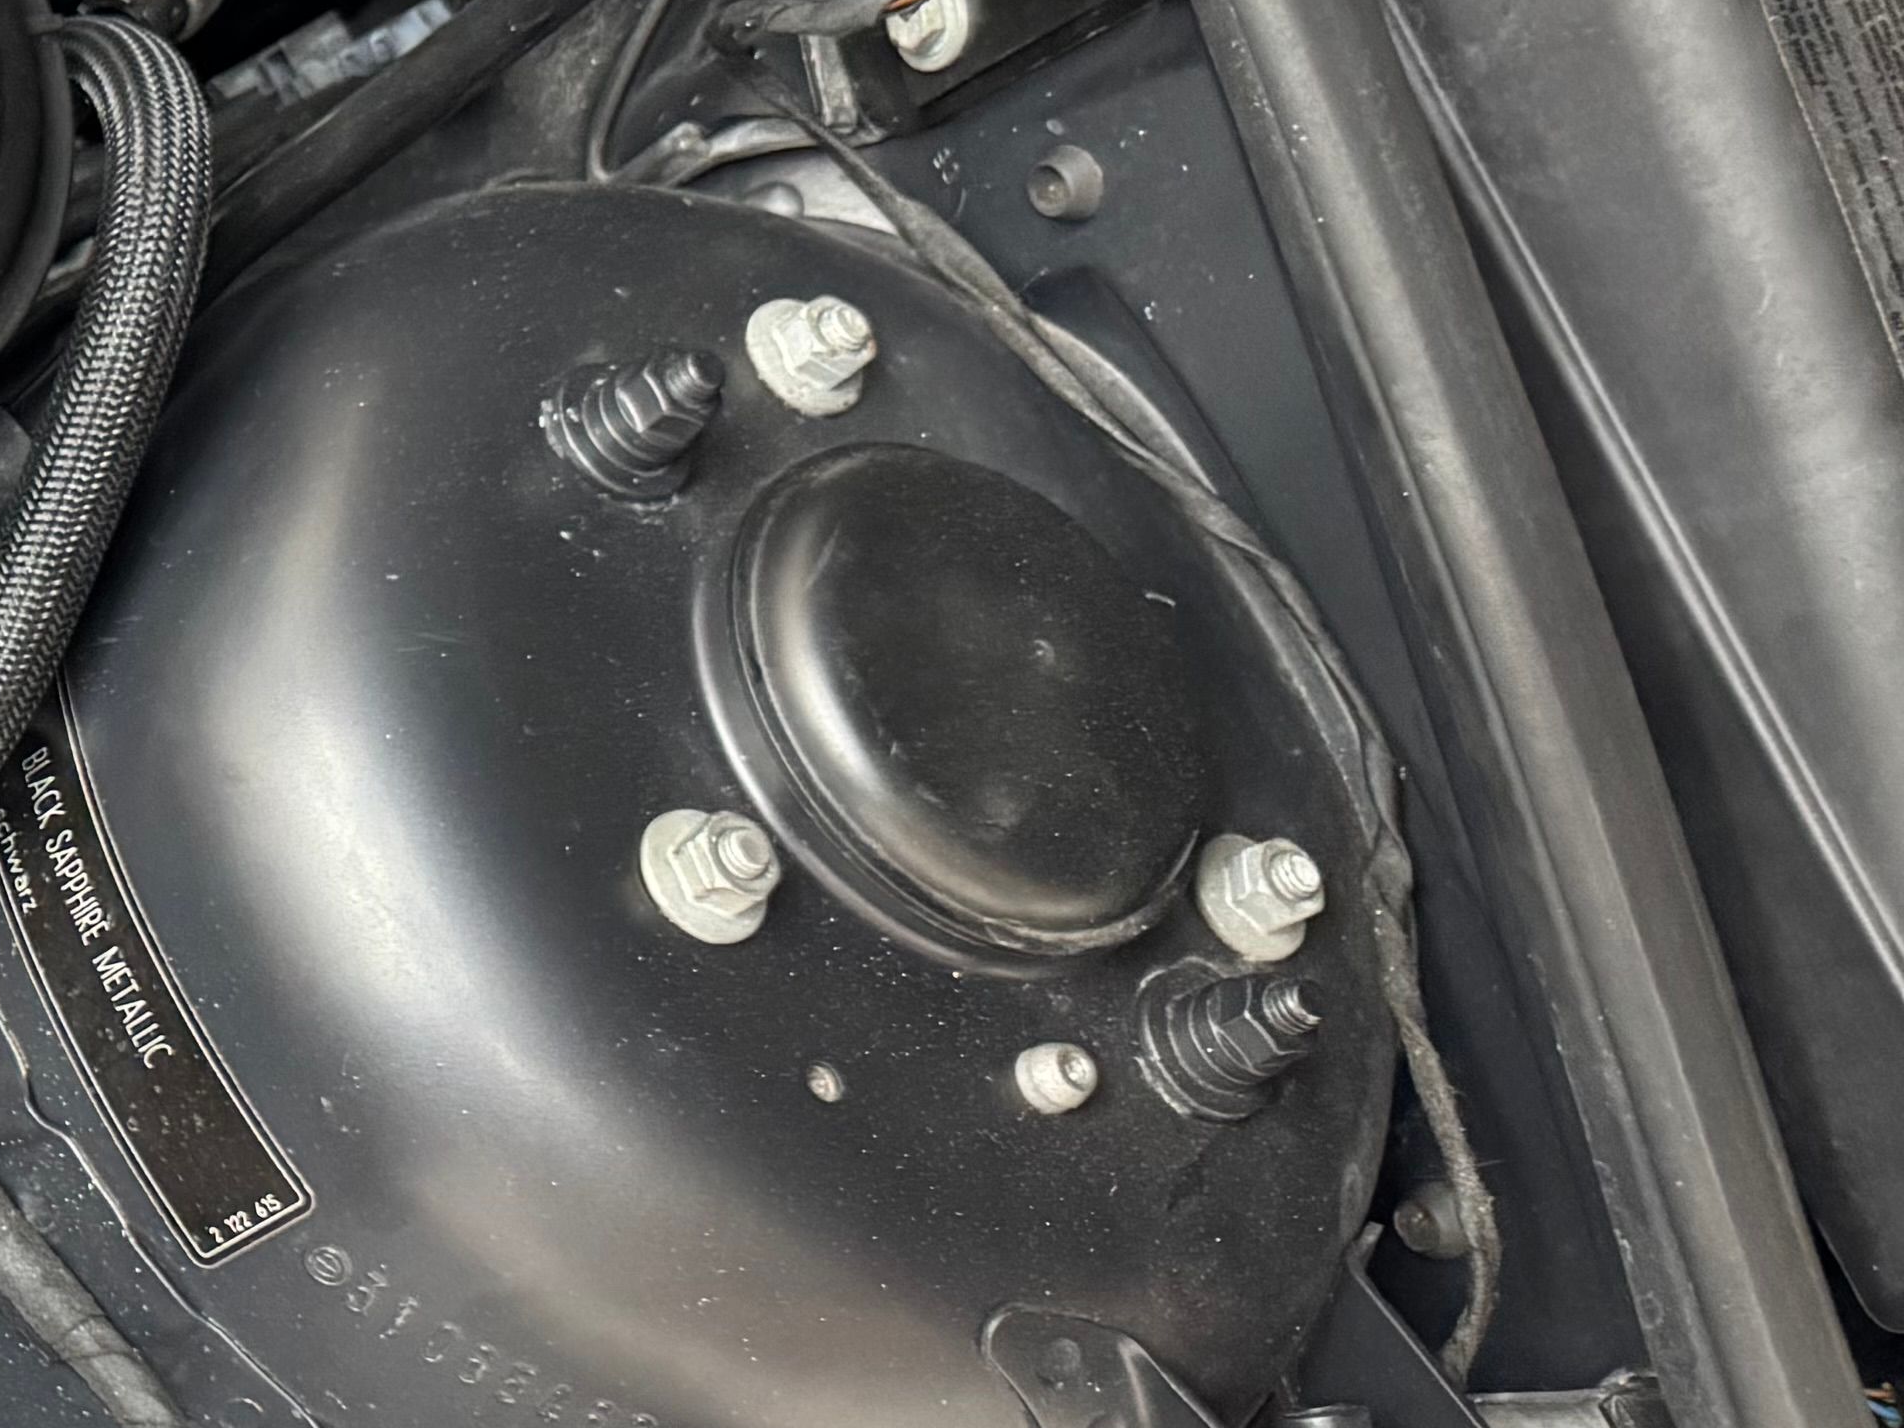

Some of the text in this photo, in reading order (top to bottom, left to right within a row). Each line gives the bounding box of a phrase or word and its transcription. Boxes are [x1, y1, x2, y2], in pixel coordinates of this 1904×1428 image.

[24, 747, 173, 1068] BLACK SAPPHIRE METALLIC
[209, 1194, 280, 1243] 2 122 615
